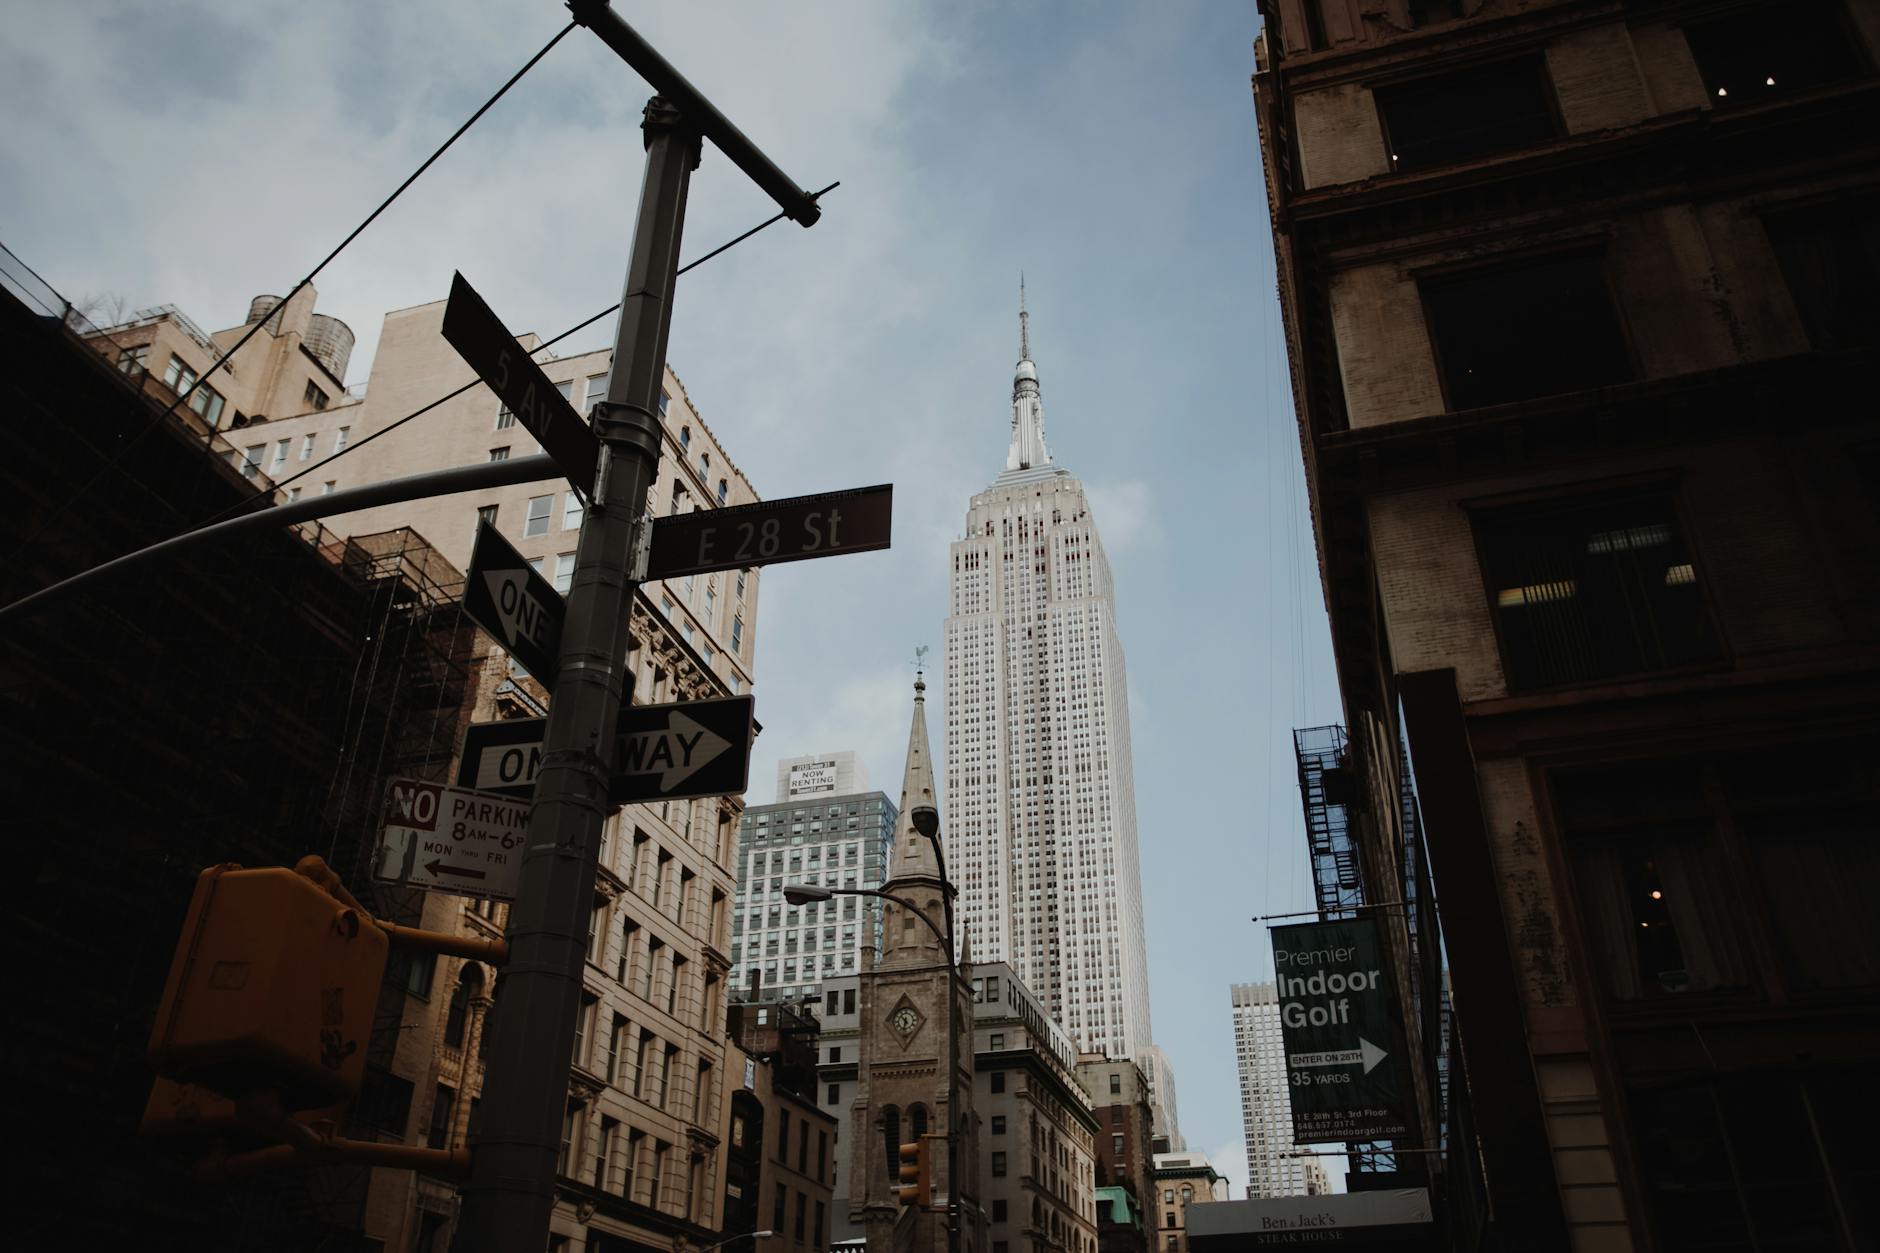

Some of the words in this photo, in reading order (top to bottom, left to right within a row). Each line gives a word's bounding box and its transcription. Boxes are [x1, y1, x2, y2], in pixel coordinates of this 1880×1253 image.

[495, 348, 512, 391] 5
[520, 382, 553, 438] Av
[697, 527, 717, 566] E
[734, 518, 781, 561] 28
[802, 508, 842, 550] St
[501, 579, 549, 648] ONE
[500, 747, 541, 782] ON
[618, 731, 704, 770] WAY
[792, 776, 833, 787] RENTING
[802, 770, 824, 779] NOW
[390, 785, 436, 824] NO
[453, 798, 527, 830] PARKIN
[424, 842, 452, 856] MON
[487, 852, 507, 865] FRI
[1275, 945, 1356, 968] Premier
[1277, 969, 1380, 998] Indoor
[1282, 998, 1350, 1029] Golf
[1292, 1055, 1322, 1065] ENTER
[1325, 1053, 1338, 1063] ON
[1340, 1052, 1362, 1062] 28TH
[1291, 1071, 1312, 1086] 35
[1314, 1073, 1351, 1085] YARDS
[1347, 1109, 1361, 1119] 3rd
[1364, 1108, 1387, 1117] Floor
[1298, 1126, 1406, 1138] premierindoorgolf.com
[1262, 1216, 1287, 1229] Ben
[1298, 1213, 1336, 1227] Jack's
[1256, 1232, 1297, 1244] STEAK
[1301, 1231, 1344, 1241] HOUSE
